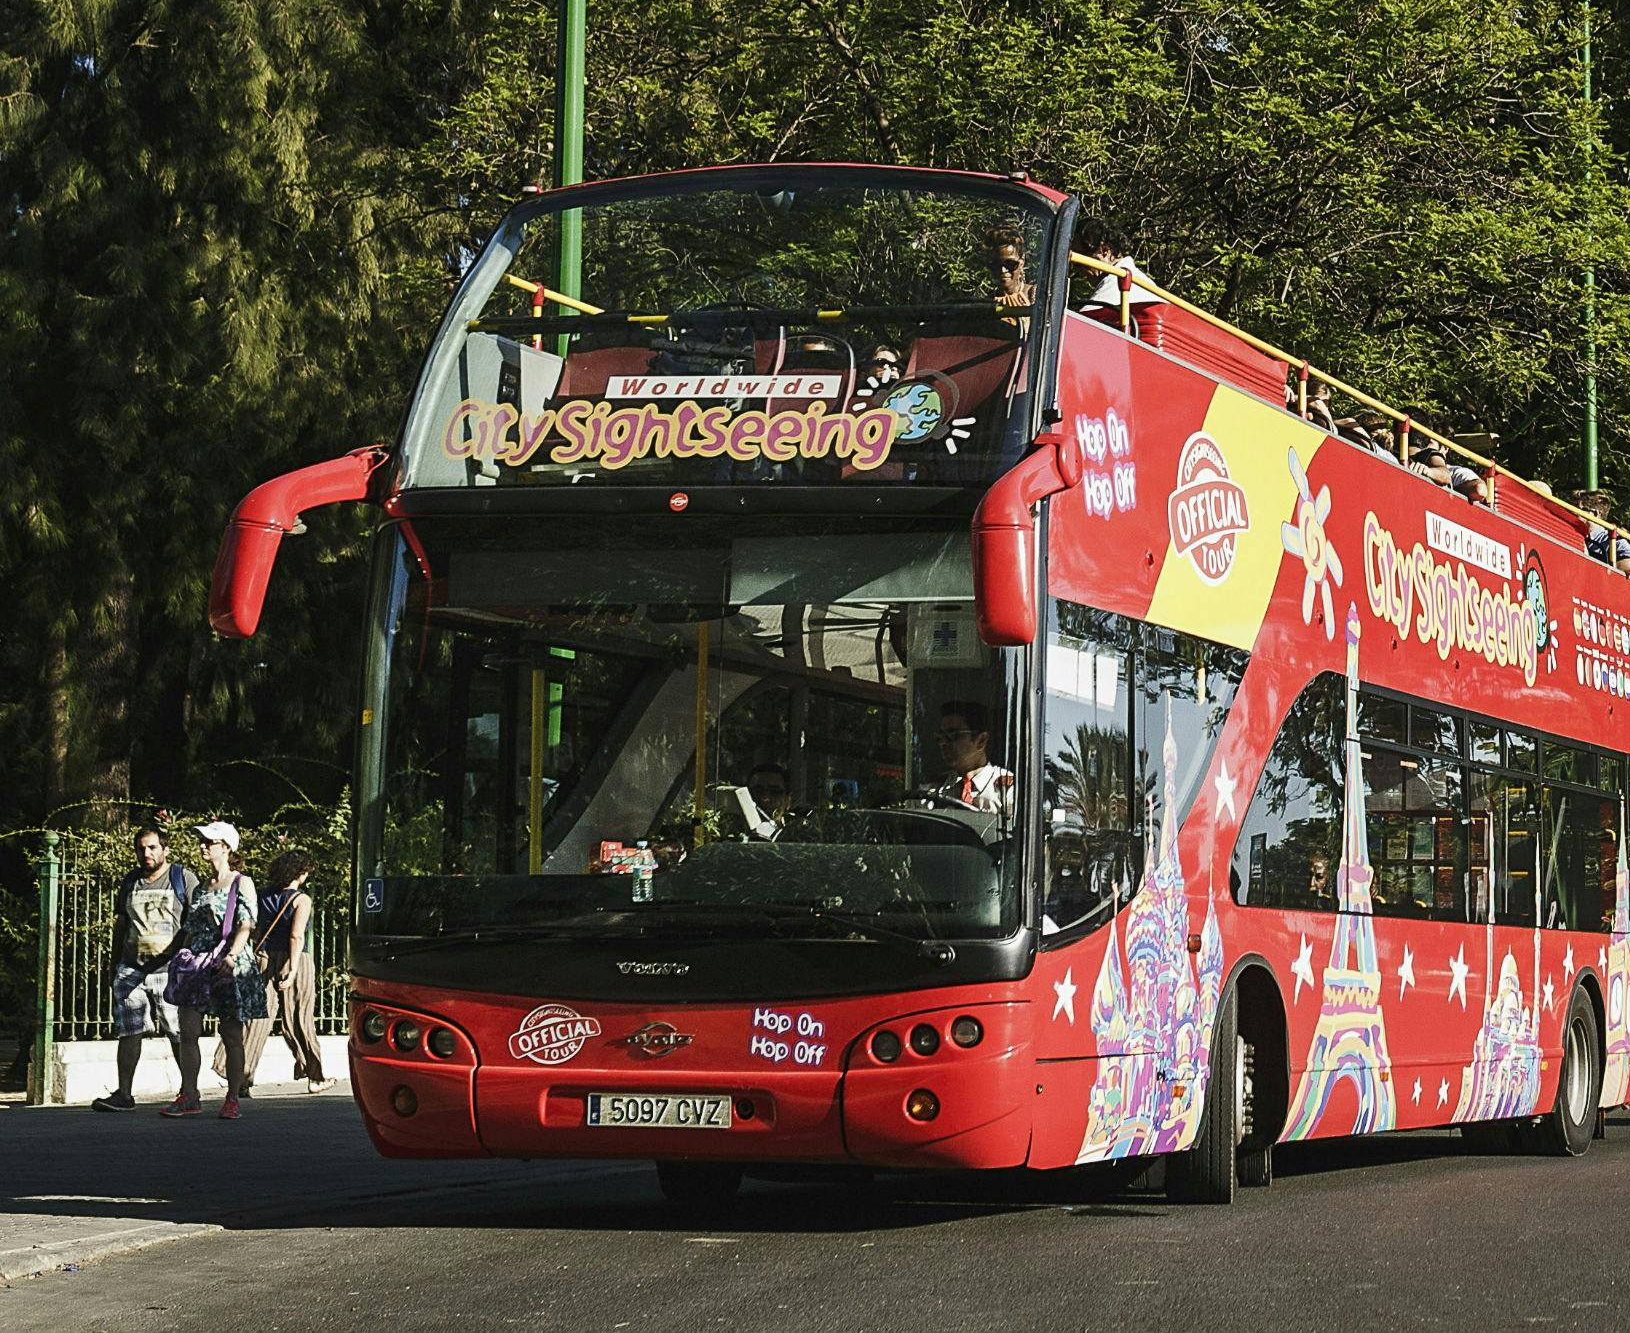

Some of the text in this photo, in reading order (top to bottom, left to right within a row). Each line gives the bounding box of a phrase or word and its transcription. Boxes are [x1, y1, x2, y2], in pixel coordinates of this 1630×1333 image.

[620, 376, 827, 396] Worldwide
[1076, 410, 1130, 465] Hop On
[1084, 463, 1136, 518] Hop Off
[1176, 489, 1247, 544] OFFICIAL
[1201, 537, 1234, 575] TOUR
[1432, 517, 1506, 573] Worldwide
[517, 1020, 596, 1053] OFFICIAL
[753, 1007, 823, 1036] Hop On
[543, 1042, 579, 1060] TOUR
[751, 1035, 826, 1066] Hop Off
[611, 1098, 722, 1125] 5097 CVZ
